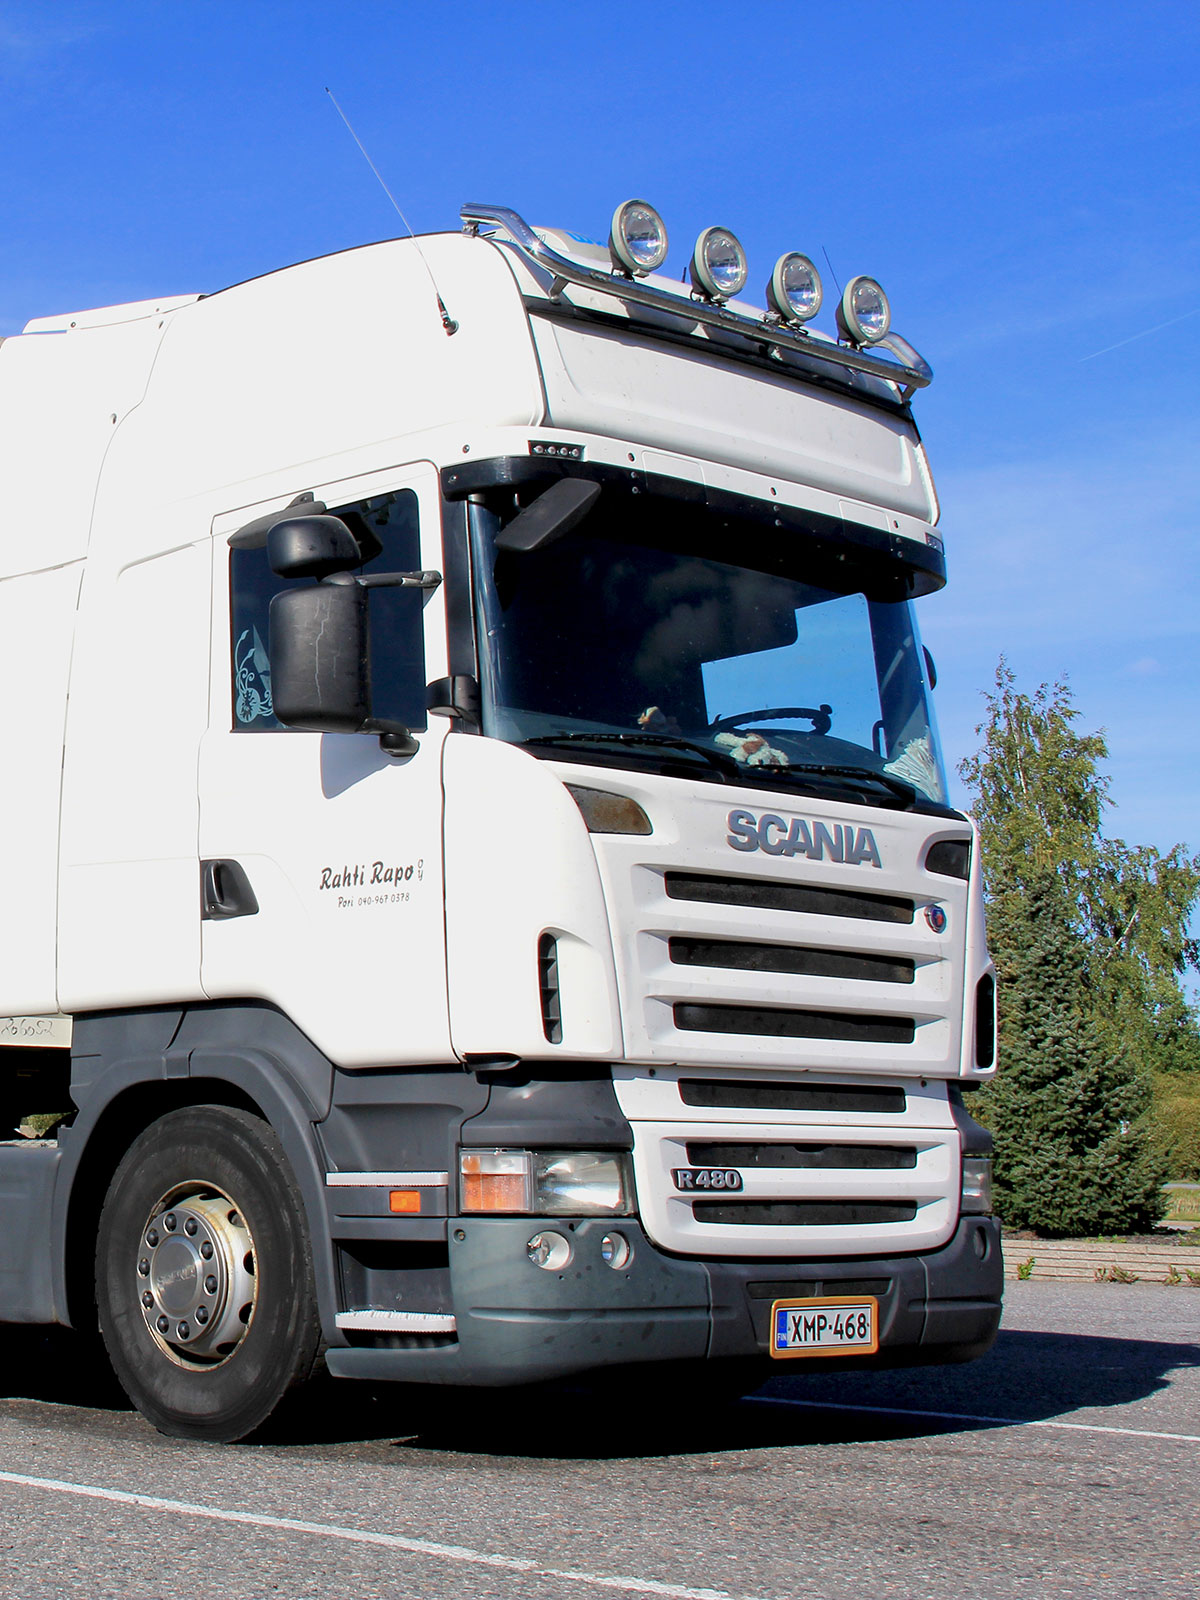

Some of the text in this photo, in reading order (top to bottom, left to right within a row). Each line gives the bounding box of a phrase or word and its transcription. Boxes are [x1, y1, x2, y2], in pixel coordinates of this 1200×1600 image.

[727, 809, 882, 869] SCANIA
[319, 864, 365, 890] Rahti
[370, 860, 414, 887] Rapo
[337, 895, 354, 908] Pori
[678, 1169, 741, 1189] R 480
[791, 1313, 867, 1343] XMP-468
